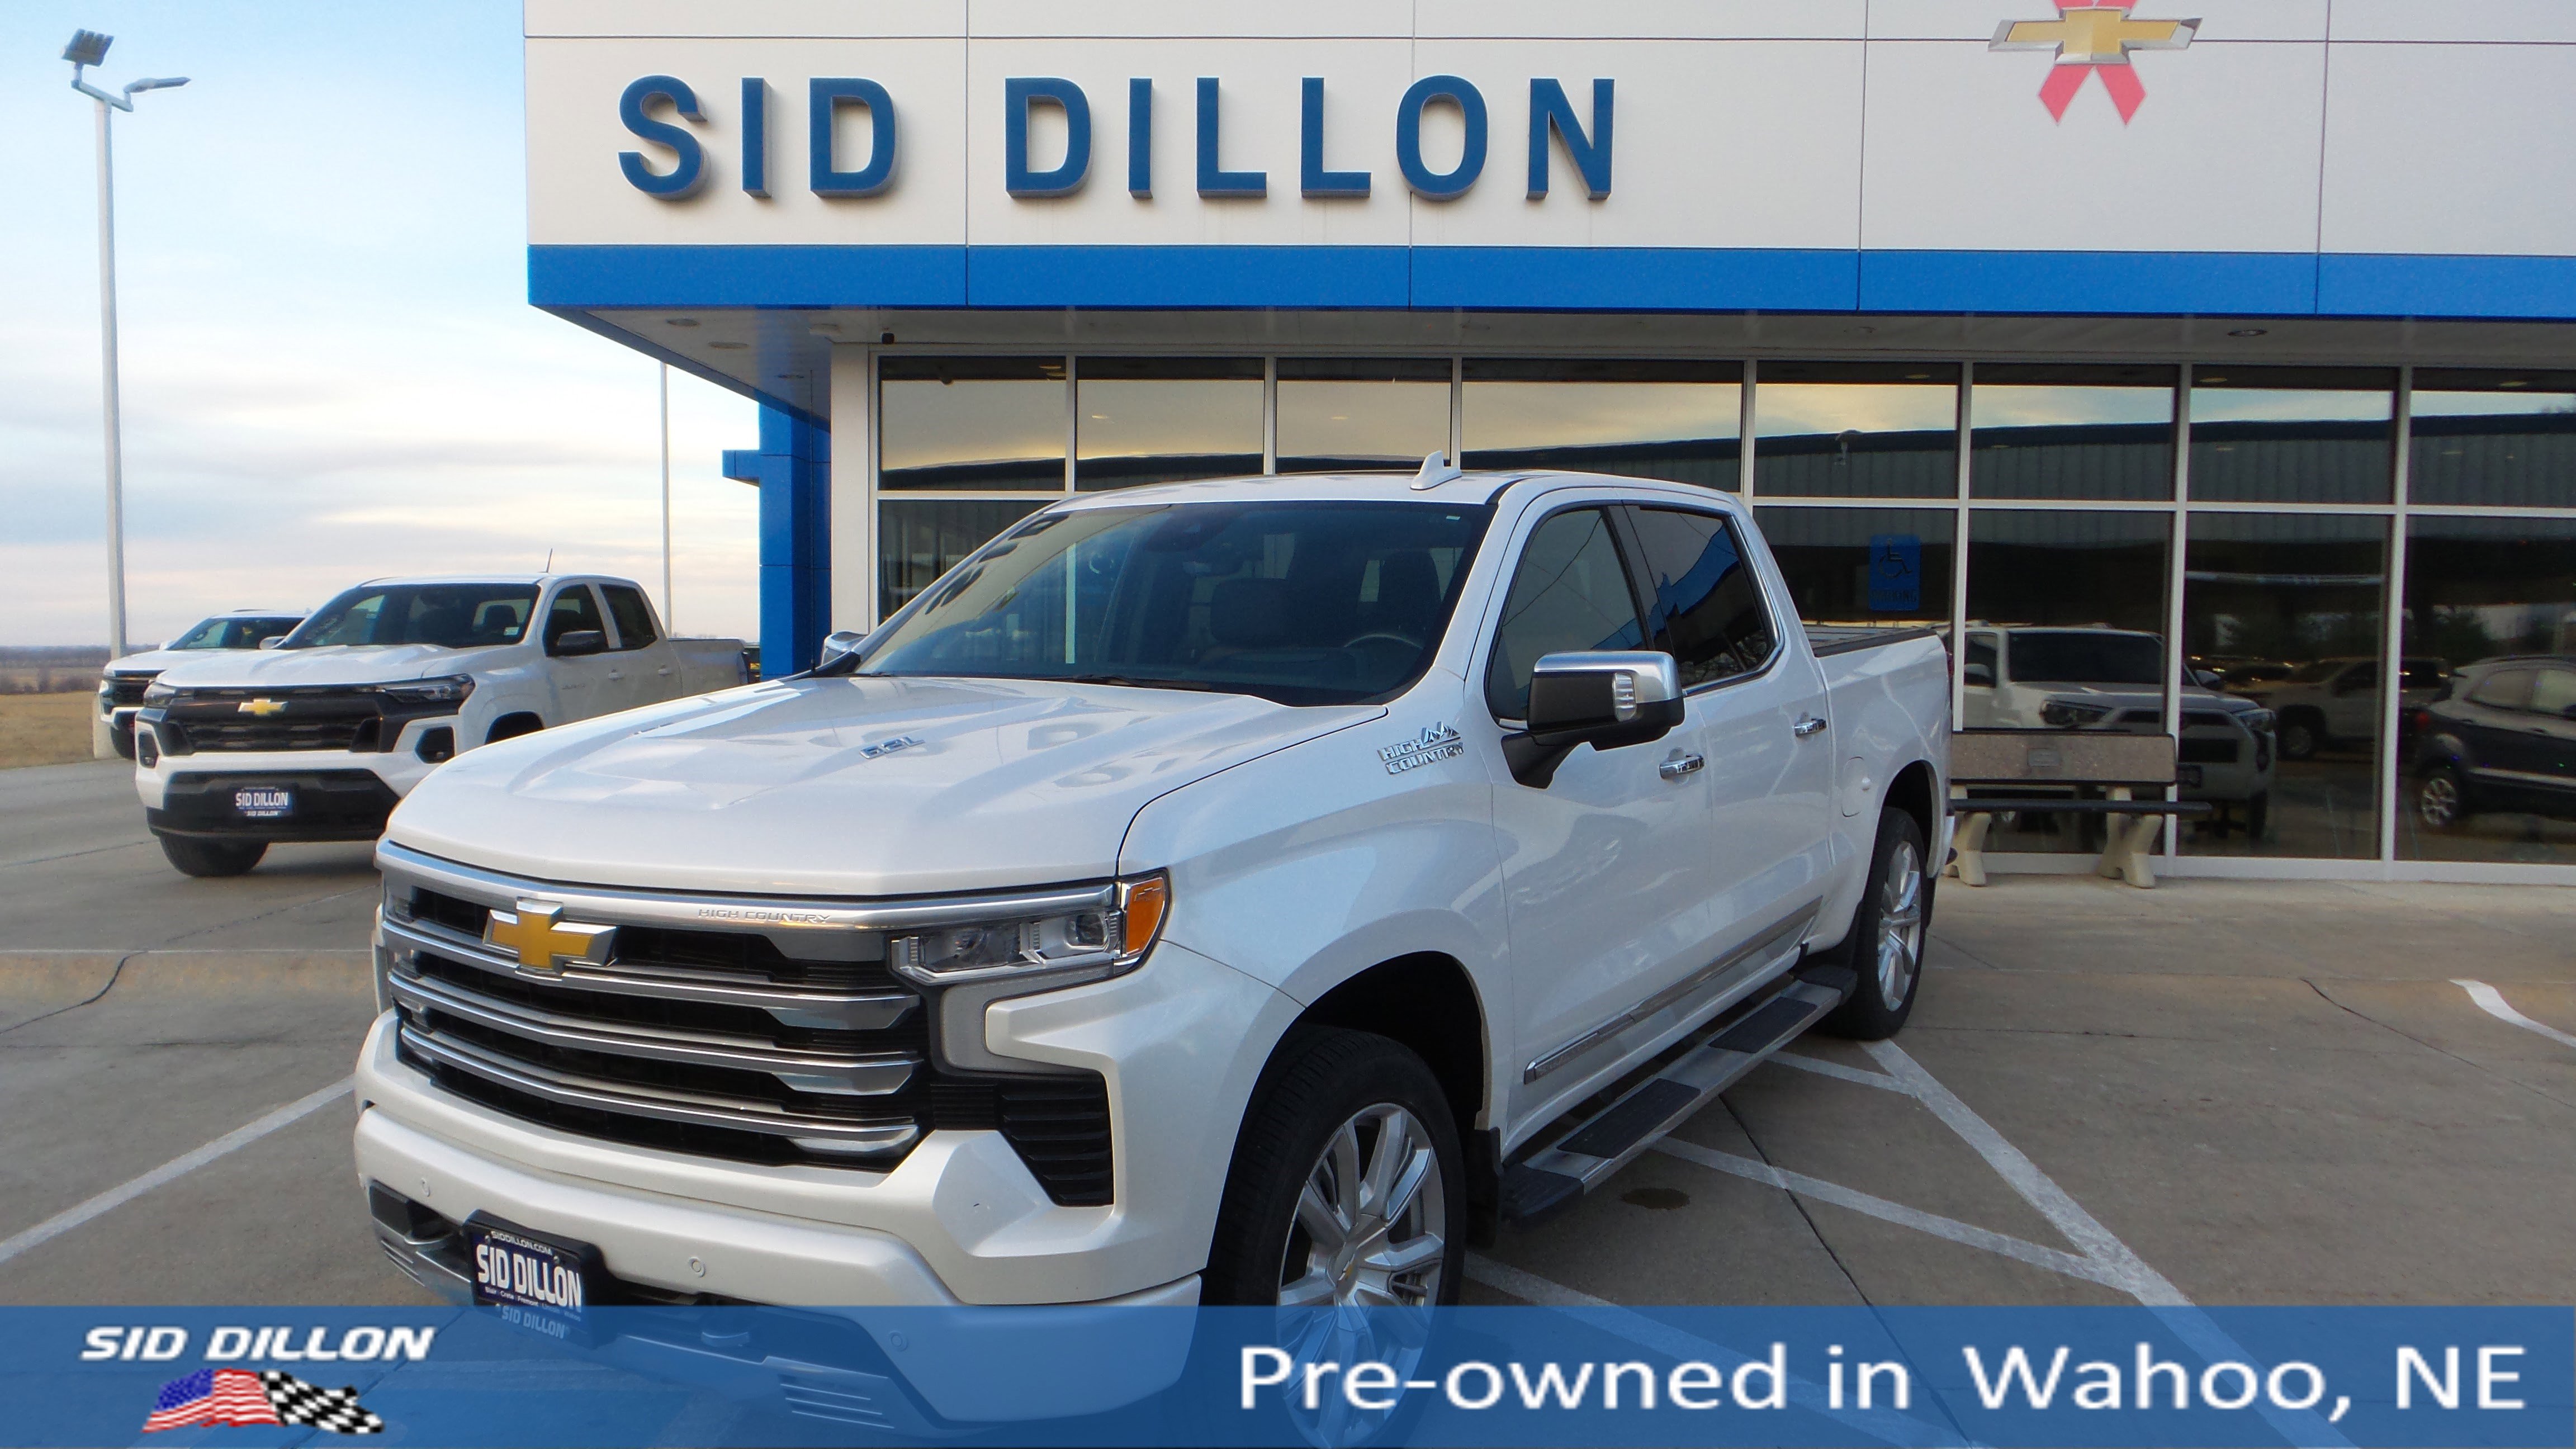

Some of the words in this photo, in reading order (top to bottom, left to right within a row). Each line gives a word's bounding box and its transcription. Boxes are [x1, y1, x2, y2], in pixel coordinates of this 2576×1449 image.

[618, 74, 898, 200] SID
[1005, 74, 1615, 201] DILLON
[1377, 737, 1429, 761] HIGH
[1385, 742, 1465, 775] COUNTRY
[235, 792, 252, 806] SID
[254, 792, 288, 806] DILLON
[698, 909, 739, 919] HIGH
[745, 911, 831, 924] COUNTRY
[490, 1230, 553, 1256] SIDDILLON.COM
[477, 1244, 510, 1289] SID
[513, 1253, 582, 1313] DILLON
[502, 1306, 521, 1324] SID
[523, 1312, 565, 1339] DILLON
